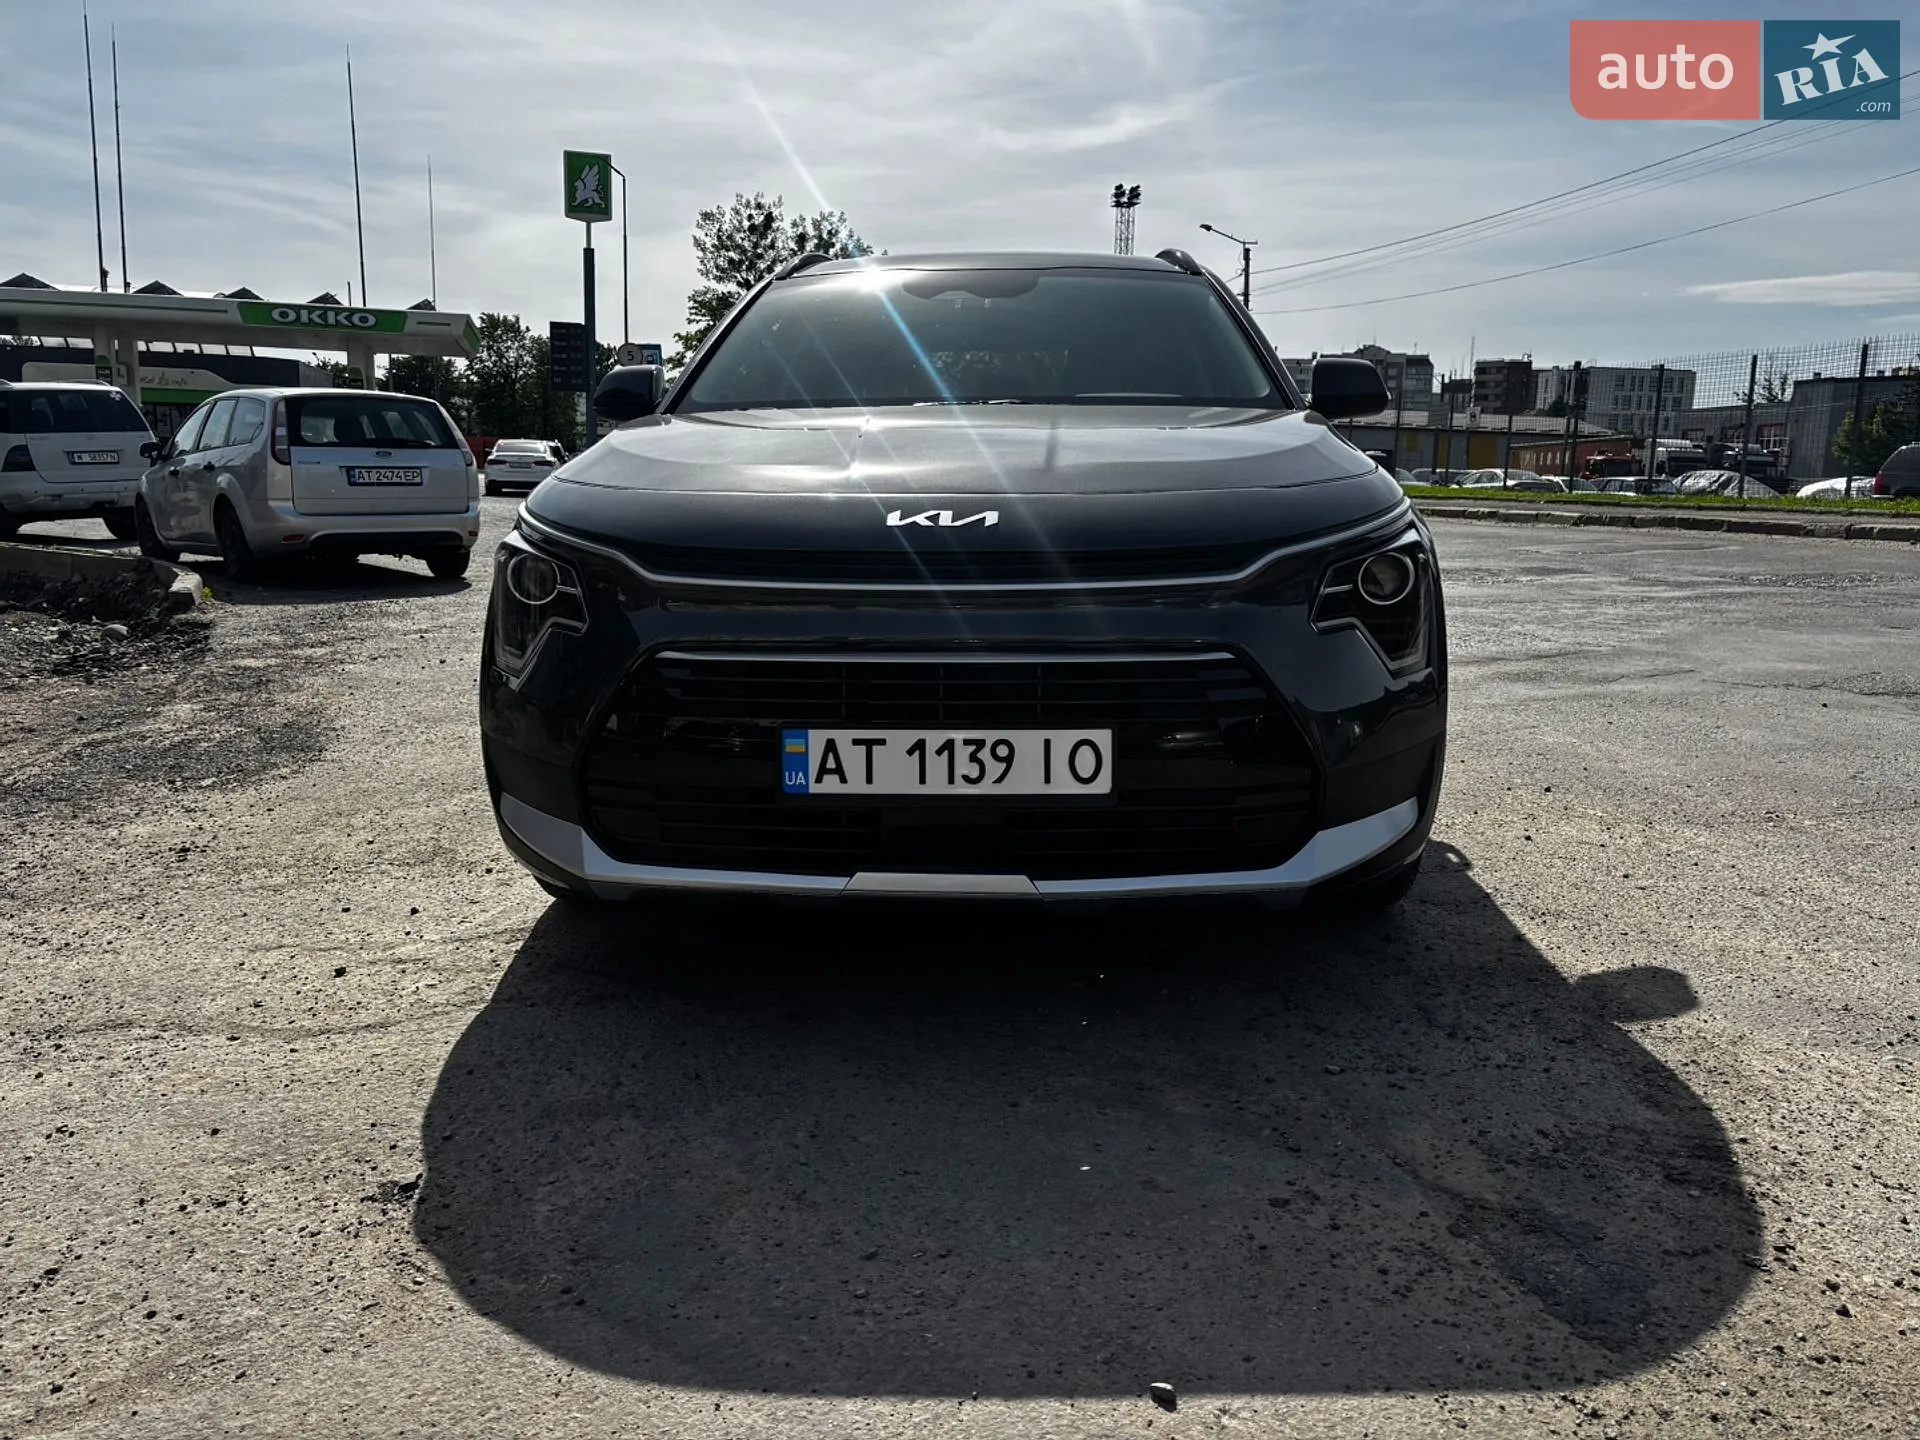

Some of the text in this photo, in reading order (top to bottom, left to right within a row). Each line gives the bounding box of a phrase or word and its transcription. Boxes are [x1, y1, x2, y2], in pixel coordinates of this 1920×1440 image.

[271, 307, 377, 328] OKKO
[627, 350, 635, 361] 5
[357, 470, 373, 481] AT
[375, 470, 403, 481] 2474
[886, 509, 1000, 527] KIA
[814, 738, 1103, 785] AT 1139 IO
[785, 771, 806, 786] UA
